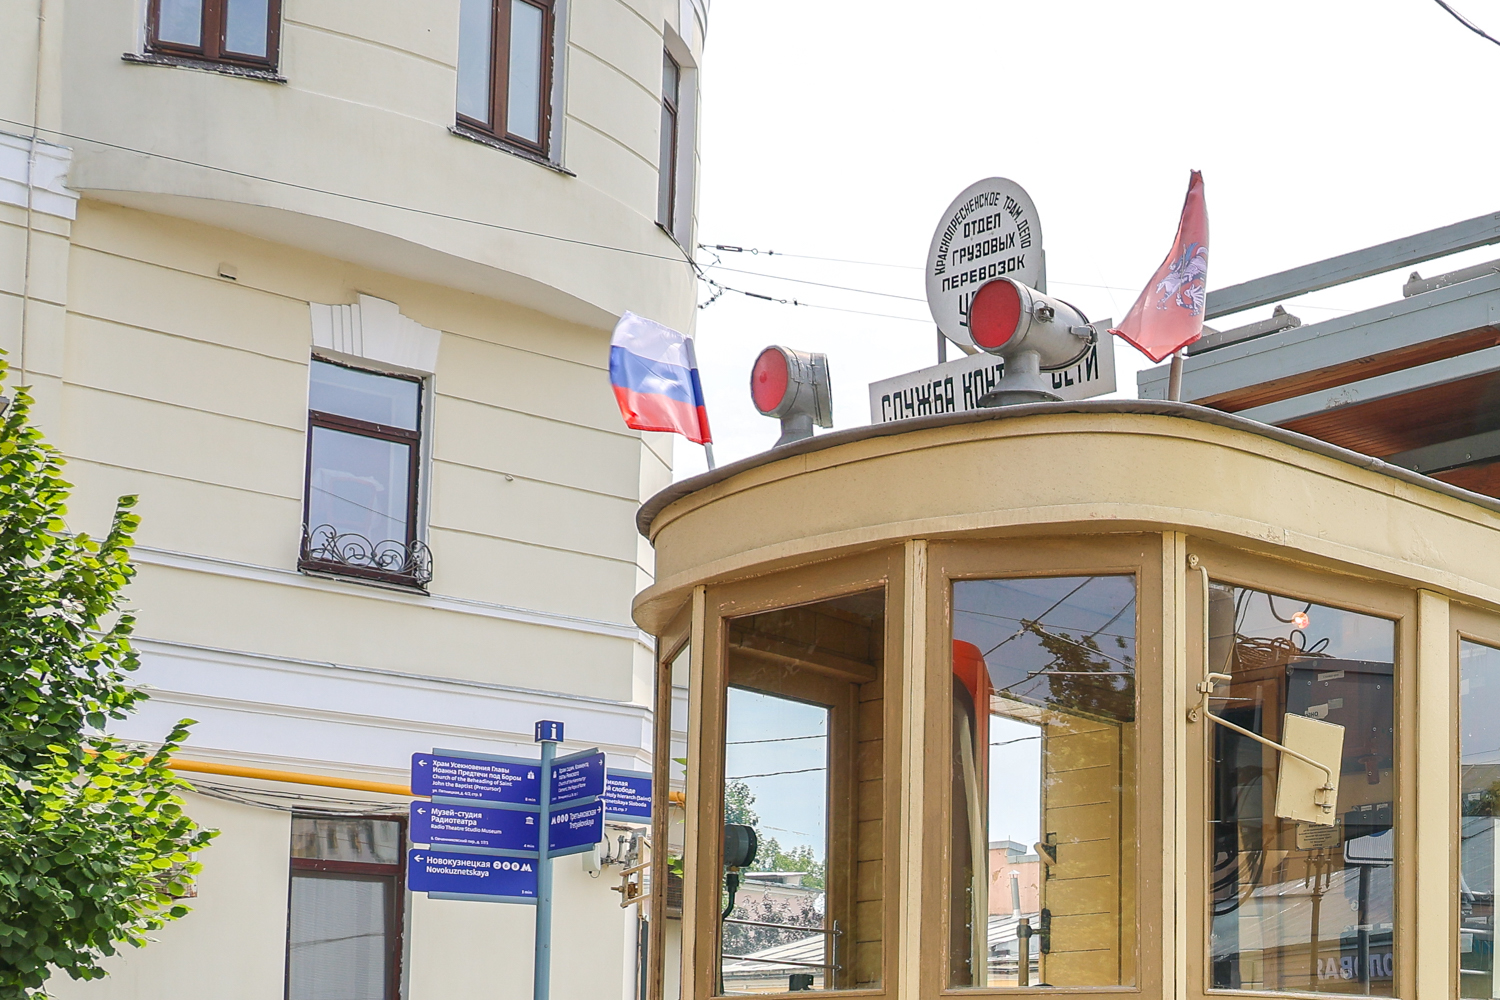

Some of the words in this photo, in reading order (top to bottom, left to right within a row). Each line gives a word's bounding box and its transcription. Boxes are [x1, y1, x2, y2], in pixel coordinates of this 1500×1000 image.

[963, 212, 1001, 239] ОТДЕЛ
[934, 191, 1001, 276] КРАСНОПРЕСНЕНСКОЕ
[1003, 195, 1024, 224] ТРАМ.
[1017, 219, 1032, 249] ДЕПО
[952, 231, 1016, 267] ГРУЗОВЫХ
[942, 253, 1026, 293] ПЕРЕВОЗОК
[881, 376, 956, 423] СЛУЖБА
[432, 767, 457, 775] Иоанна
[458, 769, 488, 778] Предтечи
[501, 773, 522, 781] Бором
[433, 760, 450, 768] Храм
[450, 762, 490, 771] Усекновения
[491, 766, 510, 774] Главы
[431, 808, 483, 819] Музей-студия
[431, 815, 477, 826] Радиотеатра
[426, 856, 491, 869] Новокузнецкая
[426, 866, 490, 878] Novokuznetskaya
